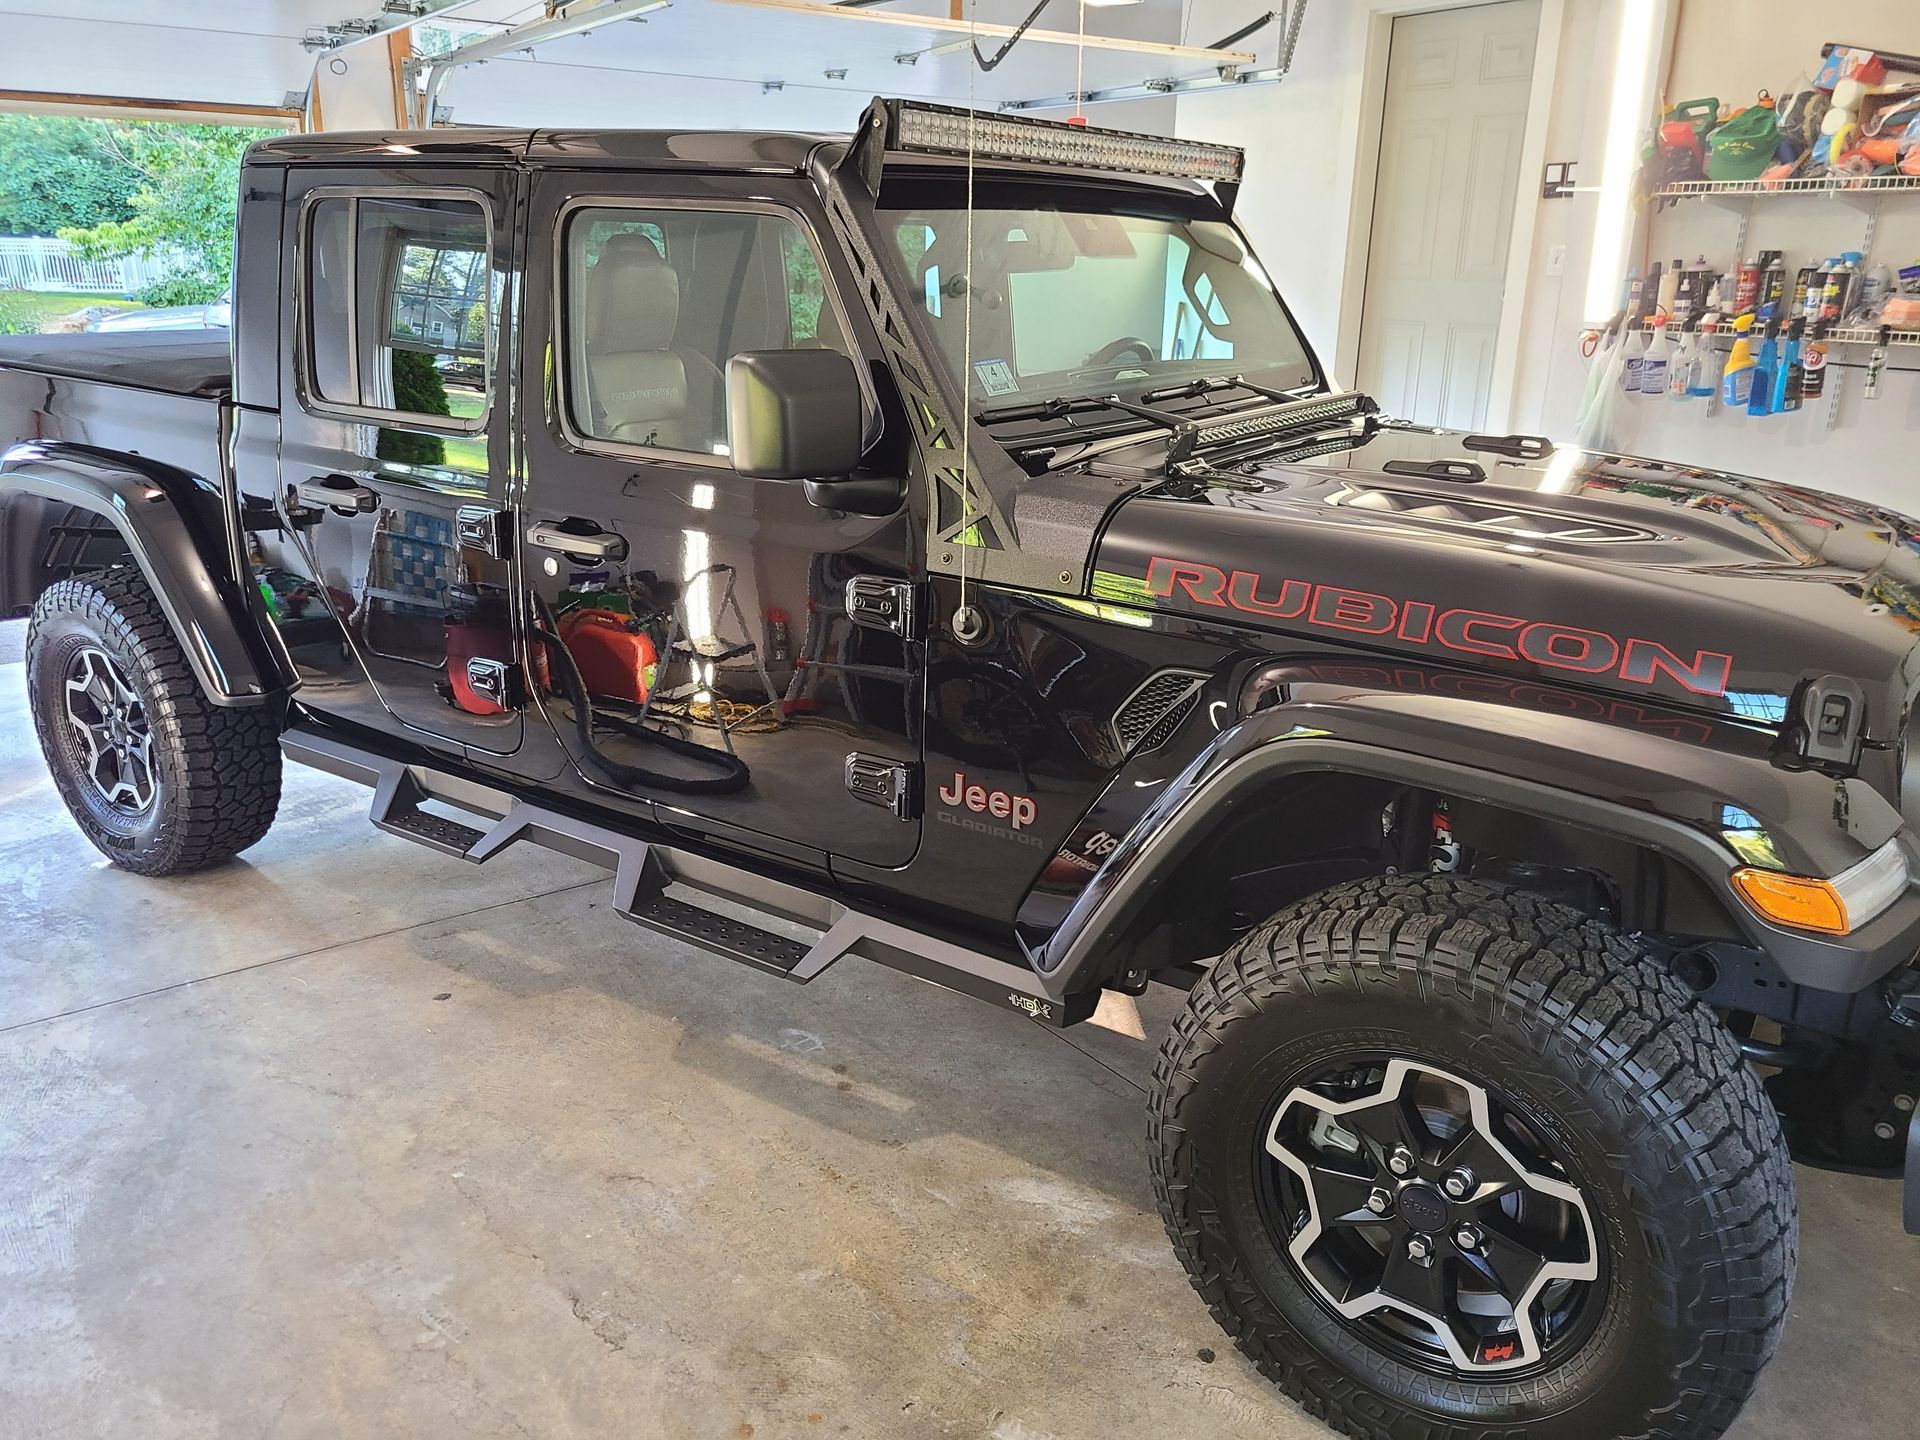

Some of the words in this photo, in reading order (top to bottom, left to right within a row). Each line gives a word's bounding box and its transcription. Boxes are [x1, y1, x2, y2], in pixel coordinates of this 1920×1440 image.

[1146, 556, 1731, 697] RUBICON
[936, 810, 1044, 849] GLADIATOR
[938, 771, 1040, 831] Jeep
